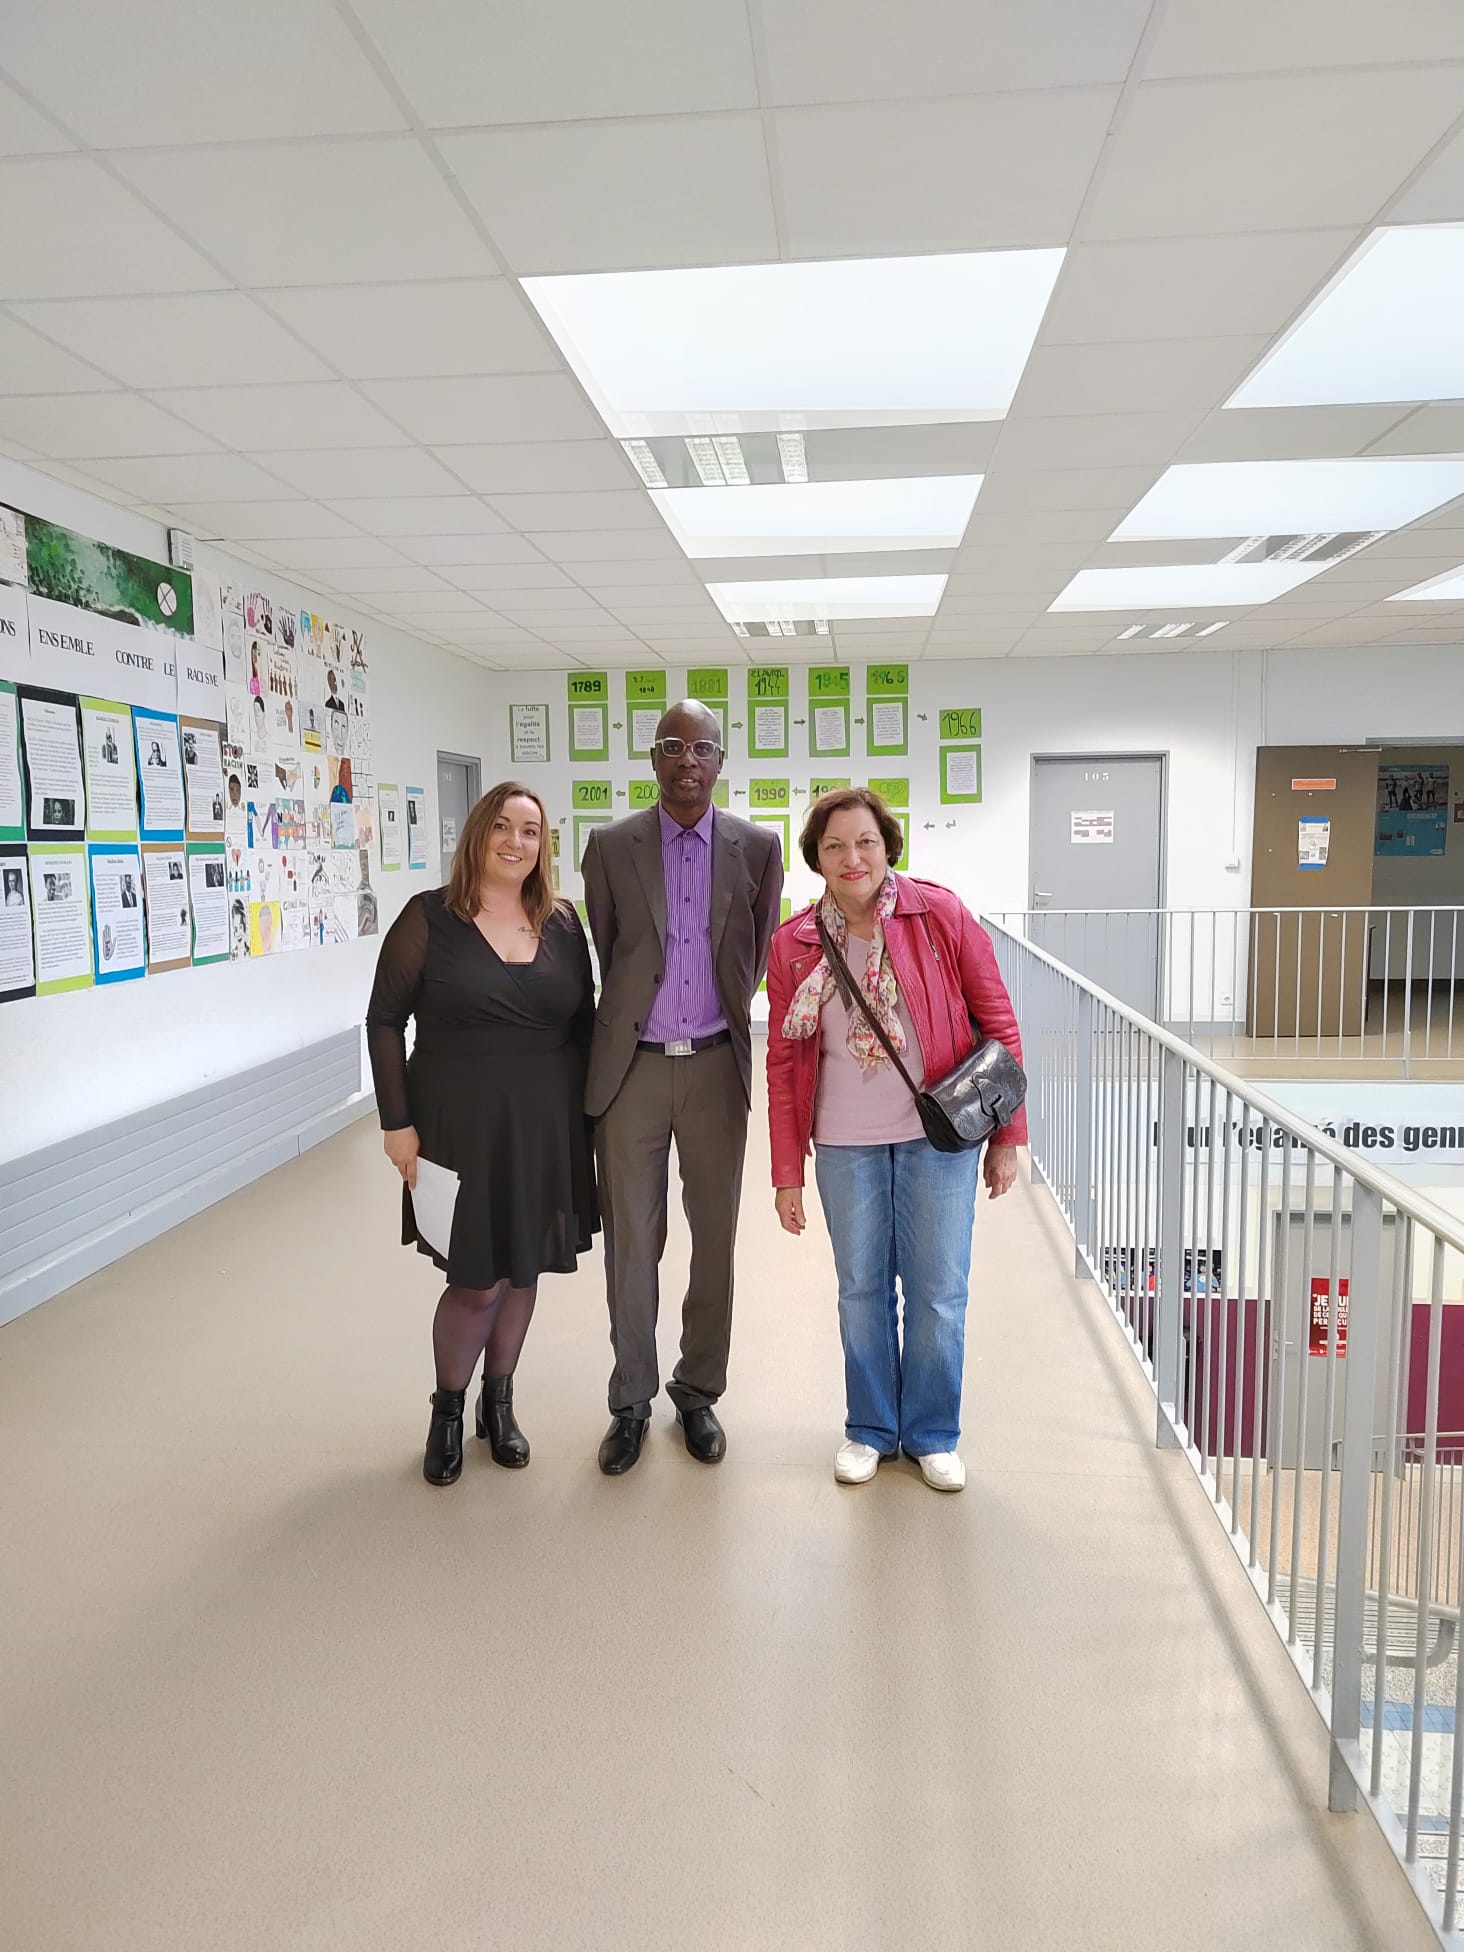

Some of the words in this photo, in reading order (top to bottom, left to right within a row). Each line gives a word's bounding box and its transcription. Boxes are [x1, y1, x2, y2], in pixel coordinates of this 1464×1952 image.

[38, 628, 95, 656] ENSEMBLE
[115, 650, 154, 671] CONTRE
[164, 662, 176, 677] LE
[187, 667, 219, 687] RACISME
[571, 680, 602, 693] 1789
[755, 677, 781, 697] 1944
[942, 711, 977, 737] 1966
[516, 736, 541, 744] respect
[1084, 771, 1110, 782] 105
[578, 786, 608, 801] 2001
[634, 783, 660, 800] 200
[754, 786, 787, 801] 1990
[1343, 1121, 1395, 1149] des
